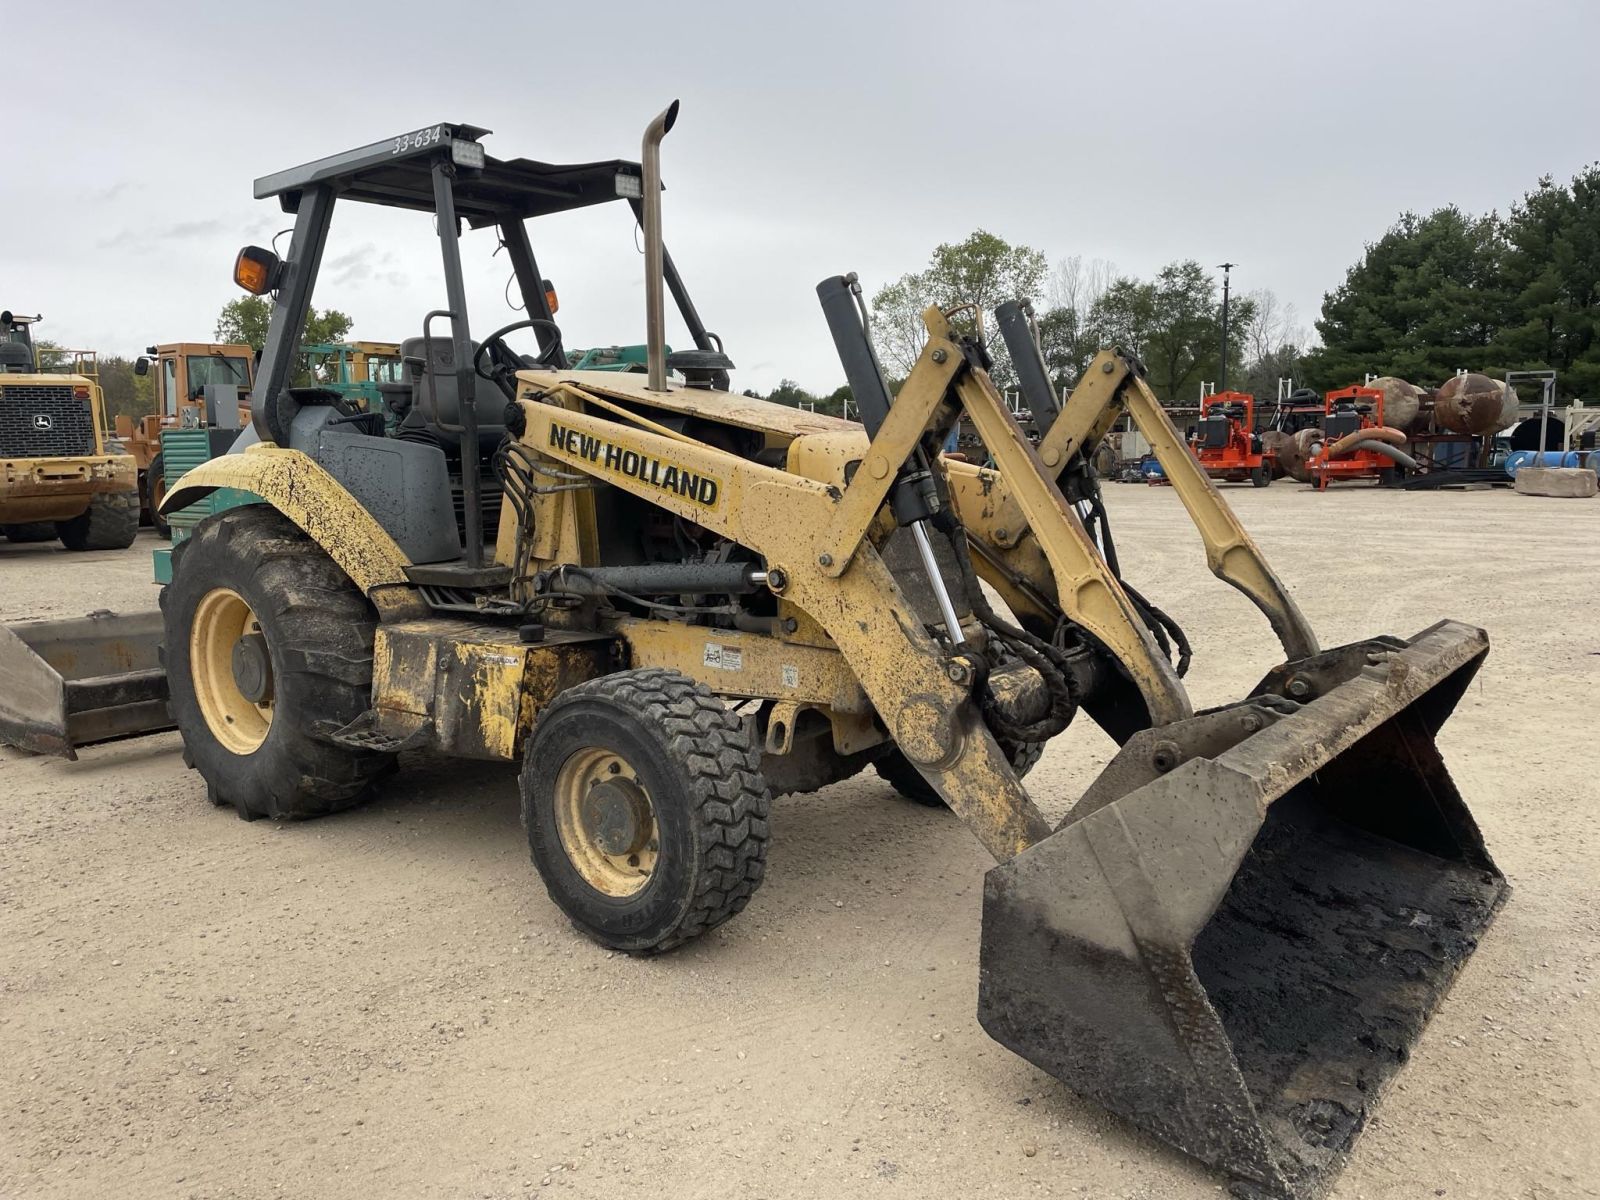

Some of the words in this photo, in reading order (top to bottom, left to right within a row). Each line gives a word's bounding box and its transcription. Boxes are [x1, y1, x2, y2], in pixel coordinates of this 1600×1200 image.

[392, 126, 441, 155] 33-634
[550, 423, 601, 462] NEW
[605, 443, 718, 506] HOLLAND
